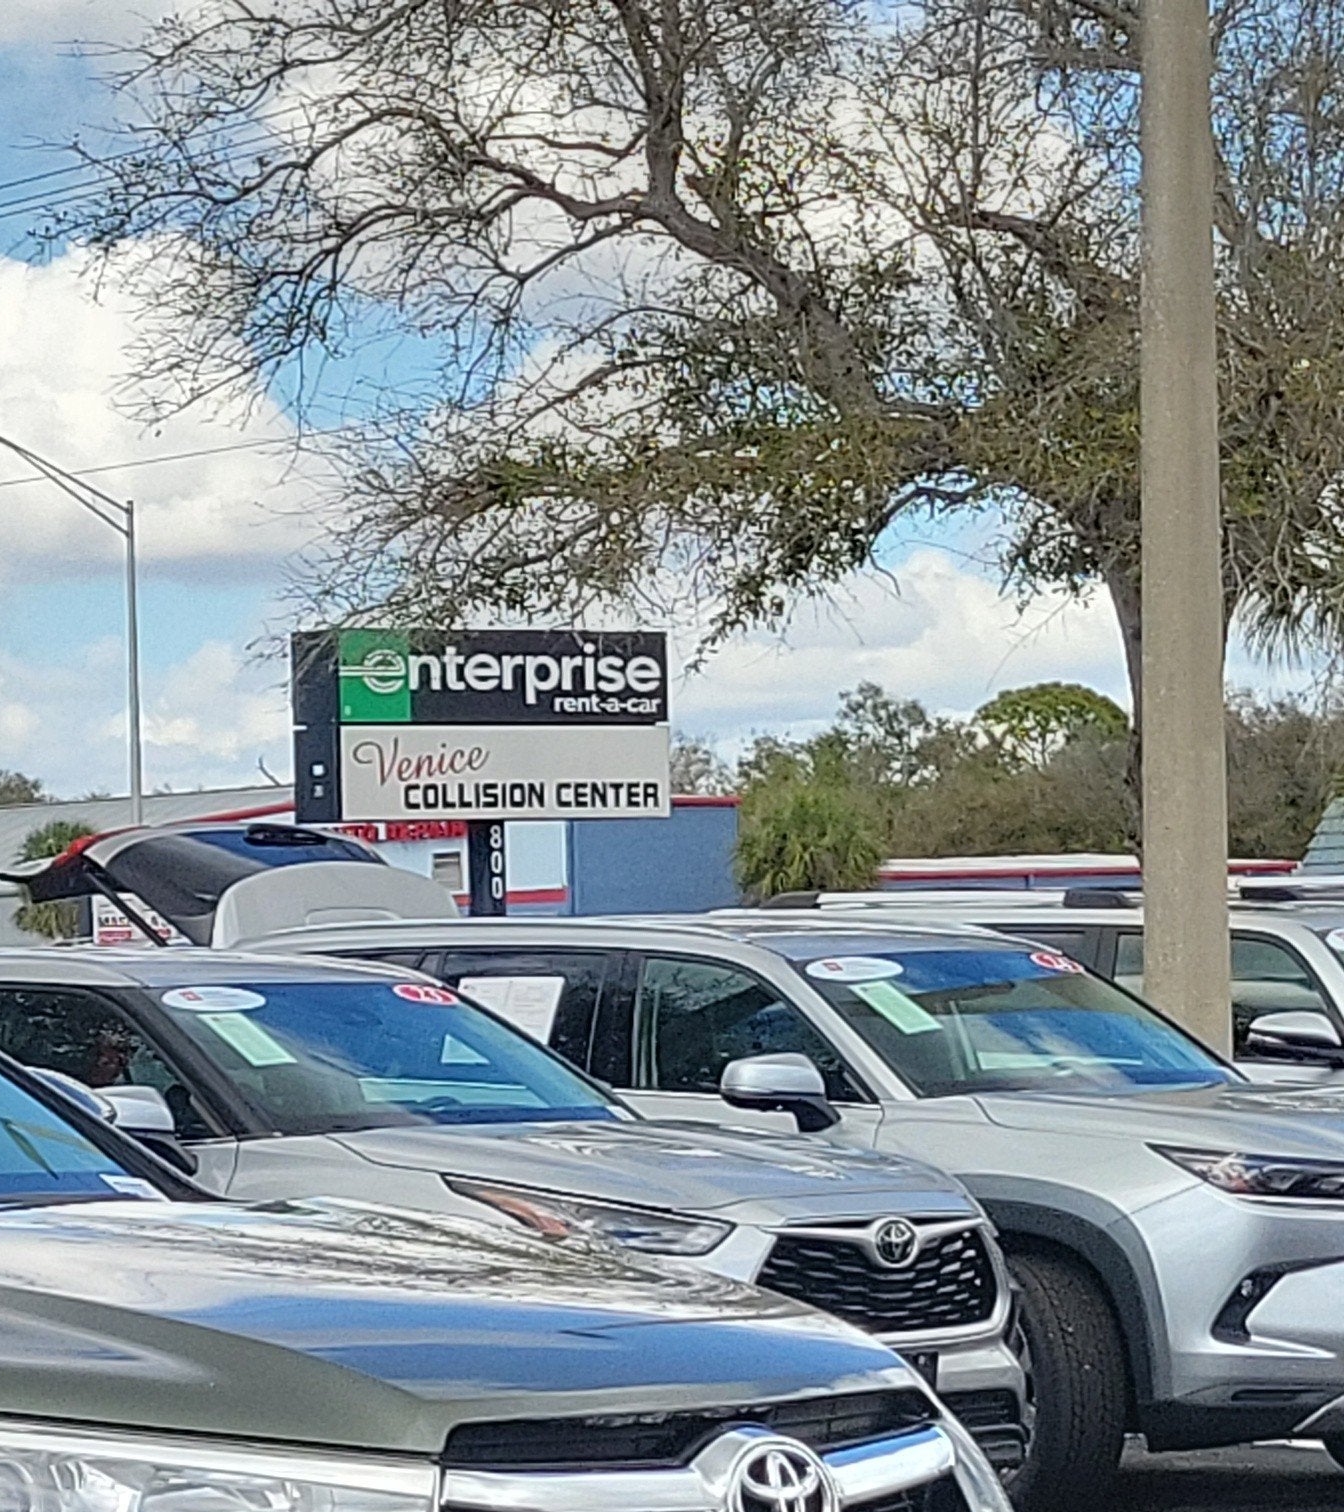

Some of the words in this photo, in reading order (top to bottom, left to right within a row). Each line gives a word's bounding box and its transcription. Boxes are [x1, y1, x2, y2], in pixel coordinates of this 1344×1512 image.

[340, 642, 661, 704] enterprise
[554, 695, 661, 714] rent-a-car
[352, 737, 491, 786] Venice
[404, 782, 545, 810] COLLISION
[556, 781, 660, 808] CENTER
